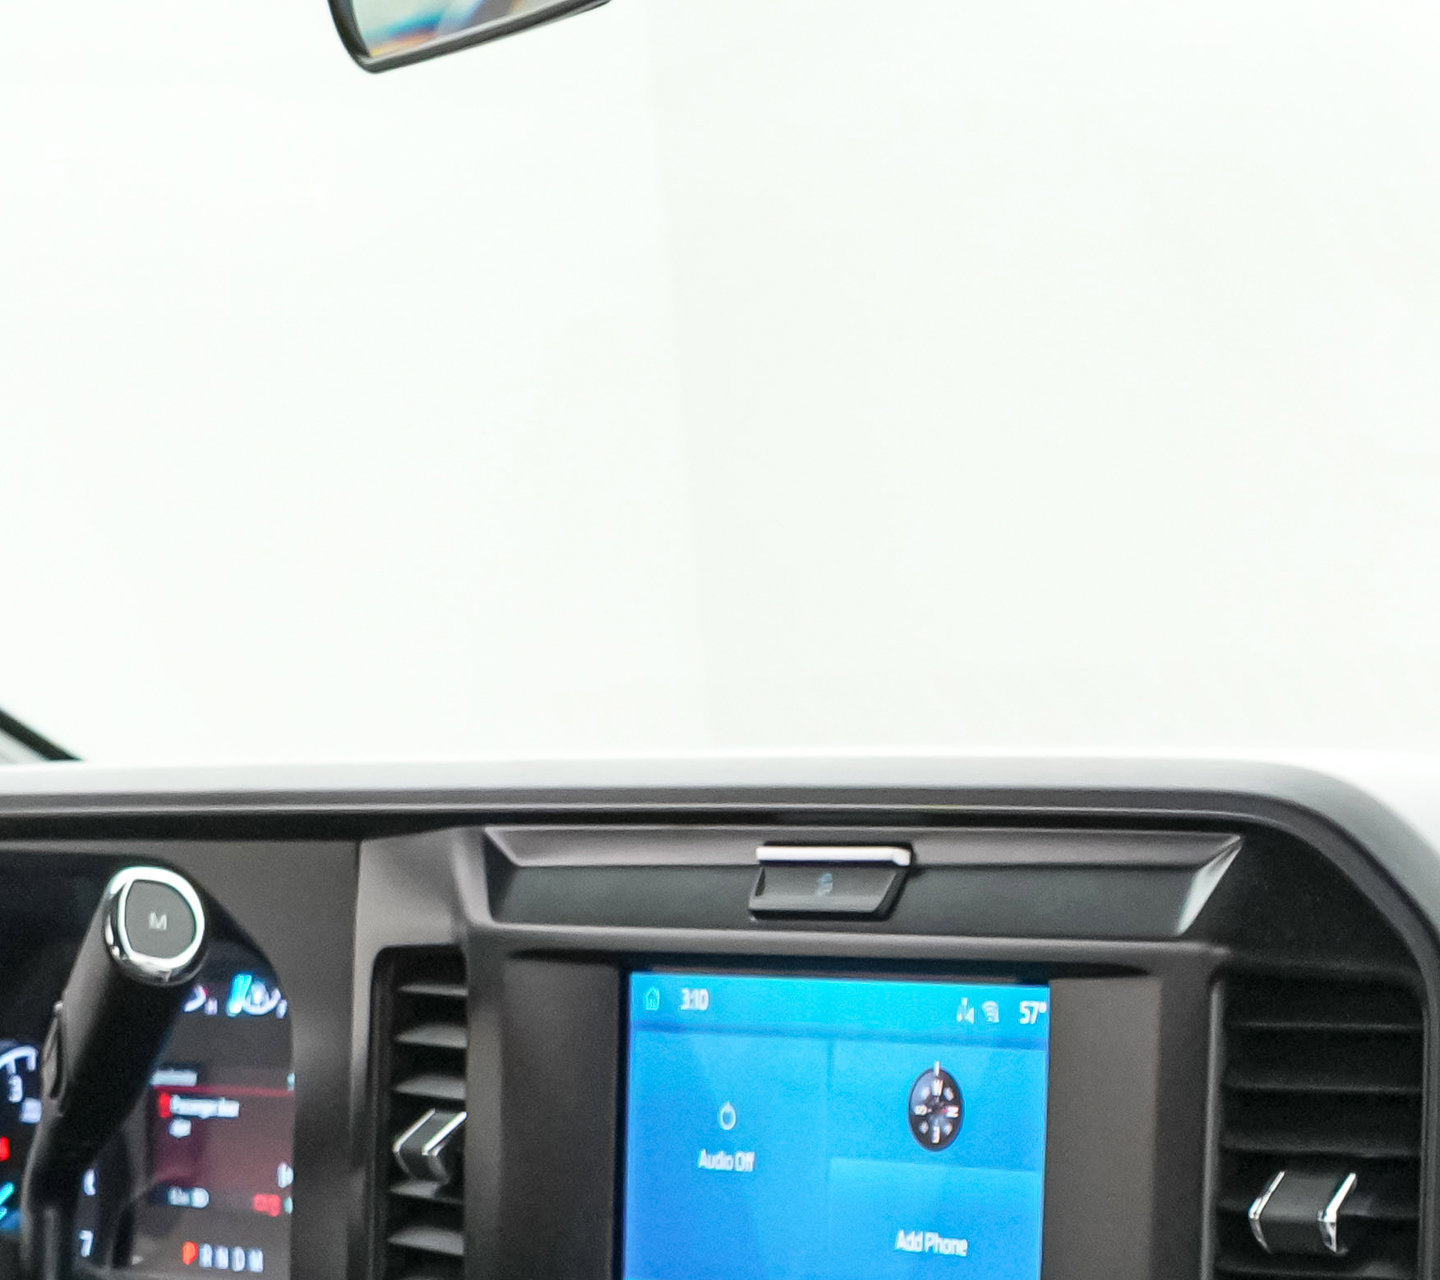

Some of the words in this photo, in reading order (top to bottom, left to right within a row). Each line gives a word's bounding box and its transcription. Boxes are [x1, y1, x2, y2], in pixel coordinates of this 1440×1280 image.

[148, 911, 167, 931] M
[1019, 1000, 1047, 1024] 57°
[698, 1149, 732, 1171] Audio
[734, 1151, 755, 1173] Off
[79, 1229, 94, 1257] 7
[894, 1229, 923, 1253] Add
[925, 1232, 969, 1258] Phone
